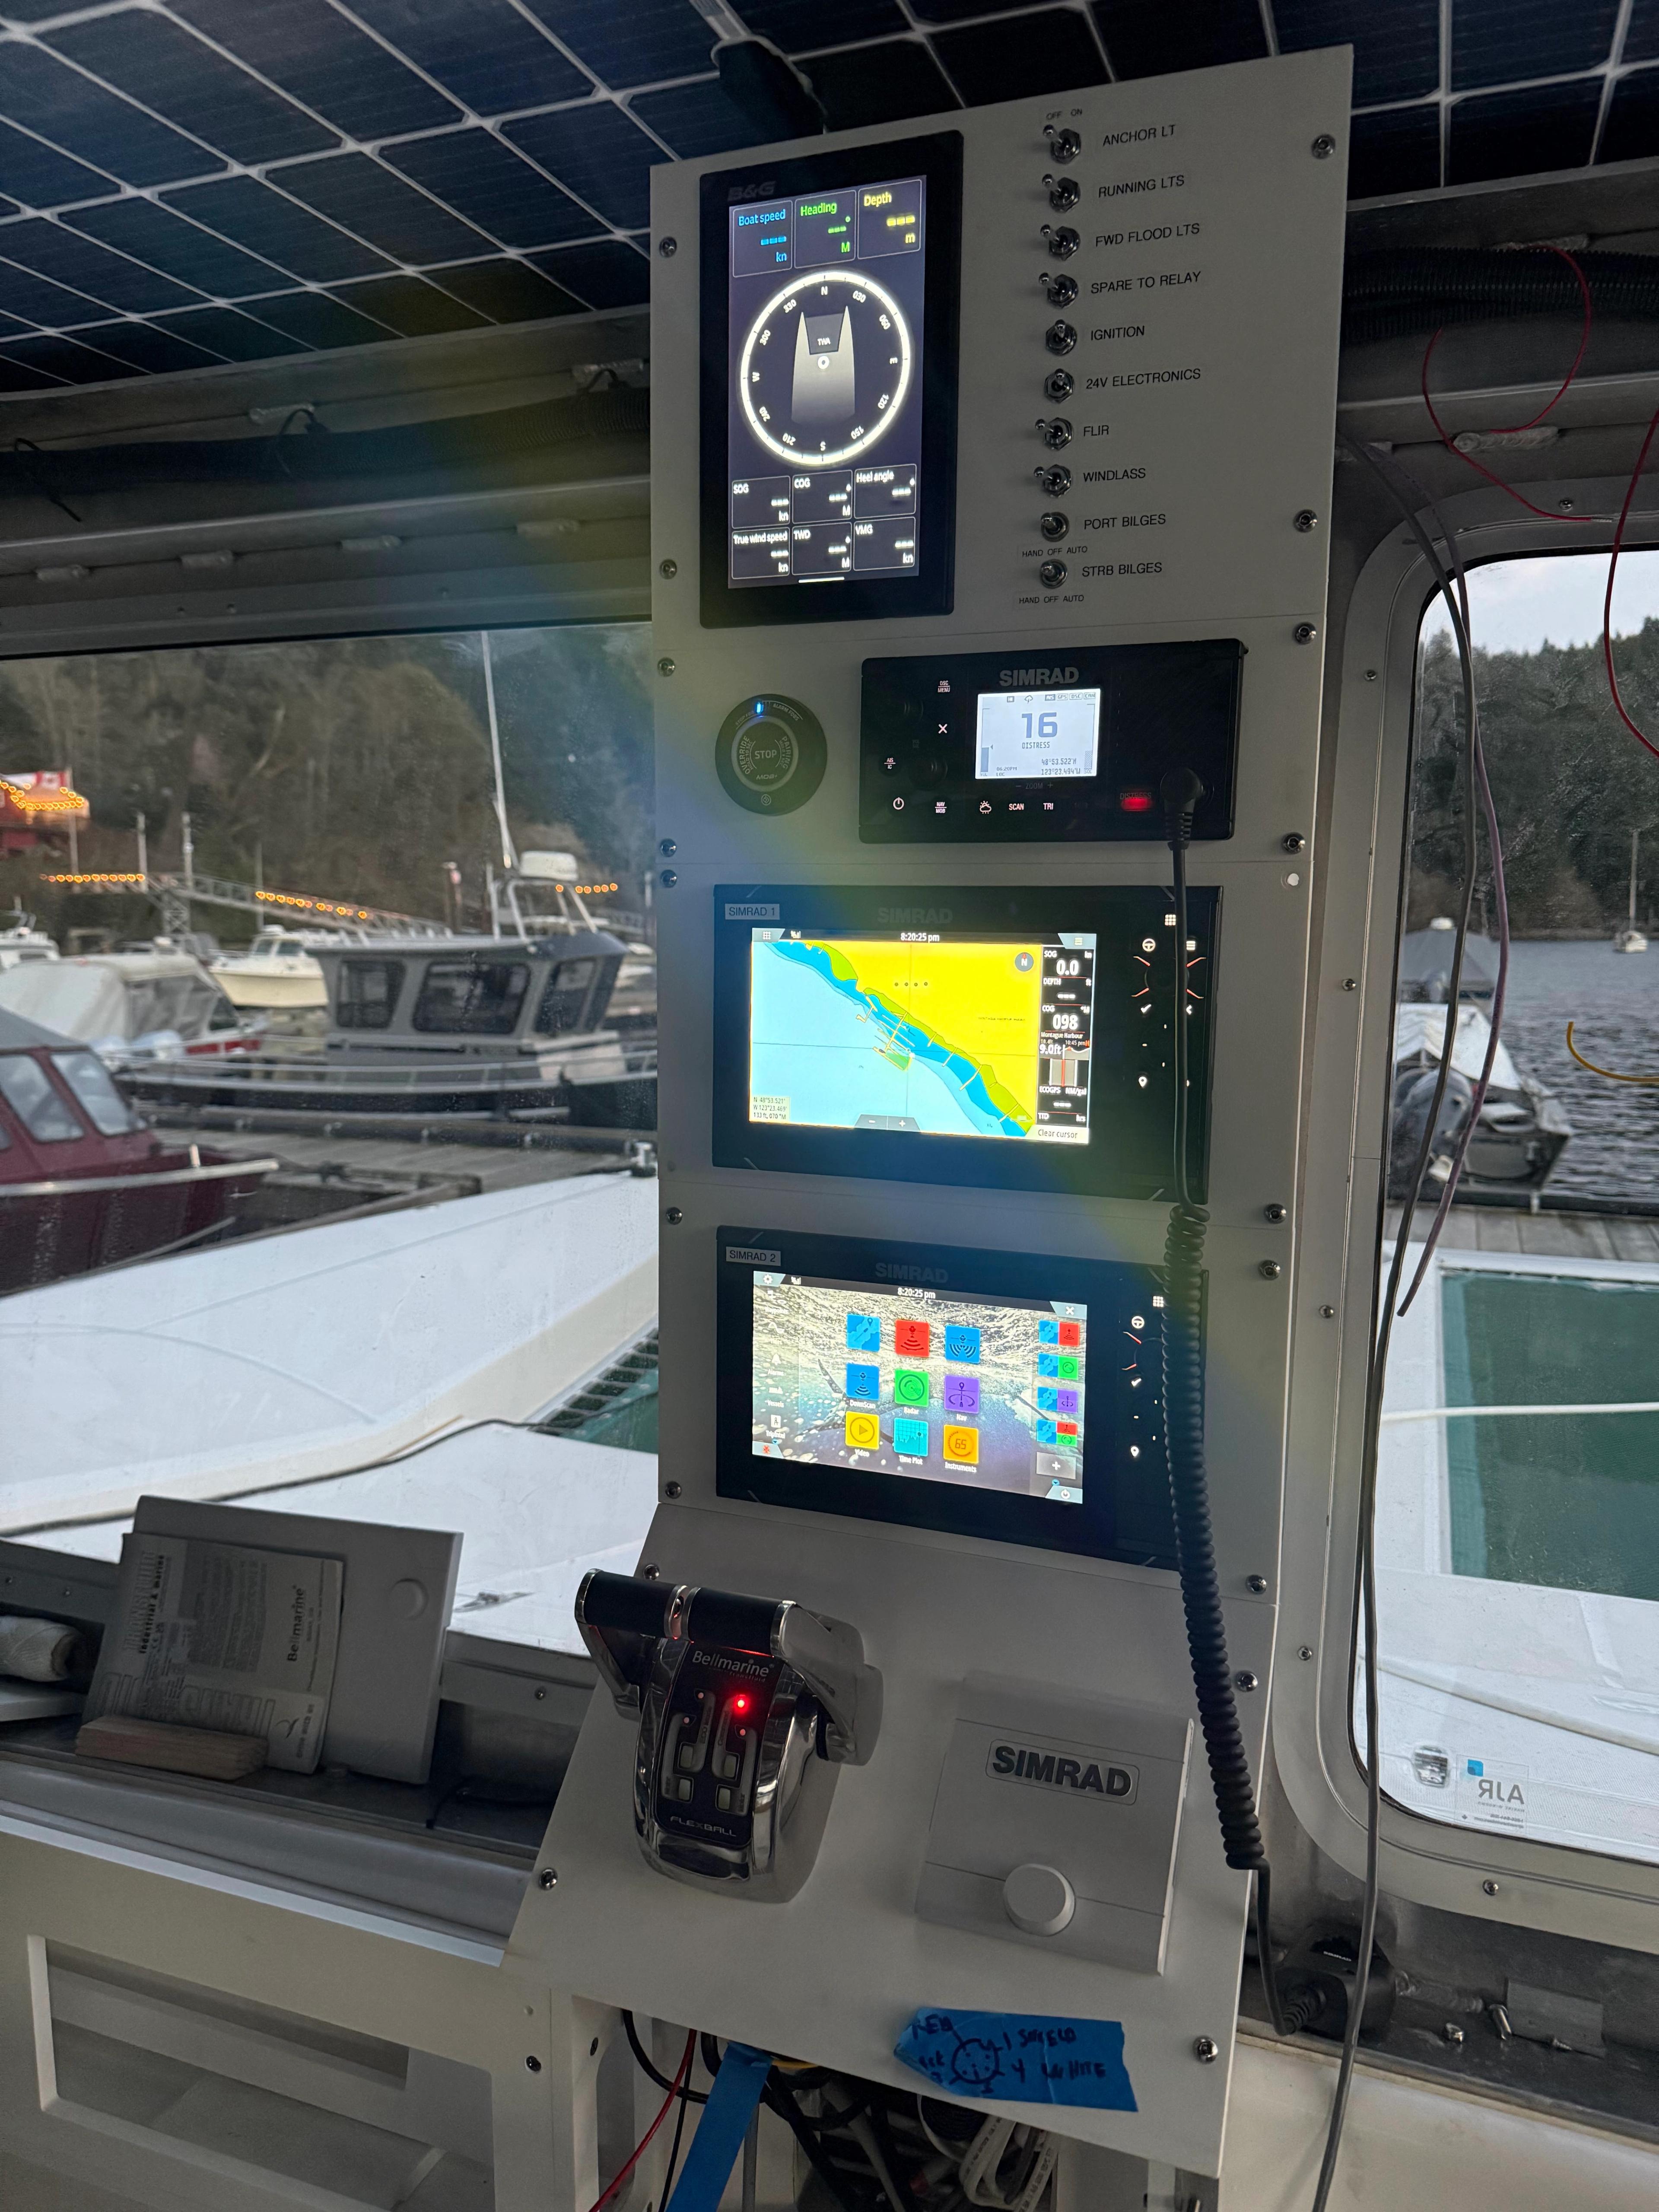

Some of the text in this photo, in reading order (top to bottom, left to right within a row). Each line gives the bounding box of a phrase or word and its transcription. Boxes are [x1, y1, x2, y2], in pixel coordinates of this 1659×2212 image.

[1046, 111, 1062, 120] OFF
[1103, 125, 1176, 146] ANCHOR LT
[728, 181, 775, 201] B&G
[1098, 175, 1184, 198] RUNNING LTS
[864, 192, 892, 208] Depth
[800, 203, 837, 216] Heading
[739, 209, 785, 226] Boat speed
[905, 234, 915, 244] m
[1096, 223, 1200, 247] FWD FLOOD LTS
[841, 242, 850, 252] M
[776, 251, 787, 263] kn
[1091, 271, 1201, 293] SPARE TO RELAY
[821, 286, 828, 295] N
[852, 290, 866, 303] 030
[783, 299, 797, 313] 330
[760, 330, 771, 346] 300
[1091, 326, 1144, 340] IGNITION
[1086, 369, 1201, 389] 24V ELECTRONICS
[877, 394, 889, 409] 120
[759, 406, 771, 422] 240
[850, 426, 864, 440] 150
[1084, 425, 1109, 436] FLIR
[782, 433, 796, 445] 210
[820, 442, 826, 451] S
[857, 470, 894, 483] Heel angle
[1084, 468, 1146, 482] WINDLASS
[733, 483, 749, 494] SOG
[794, 478, 810, 489] COG
[779, 511, 789, 521] kn
[842, 505, 850, 516] M
[1084, 514, 1166, 530] PORT BILGES
[794, 530, 811, 540] TWD
[855, 524, 873, 535] VMG
[734, 531, 788, 544] True wind speed
[842, 557, 850, 568] M
[903, 553, 913, 563] kn
[778, 562, 788, 572] kn
[1082, 563, 1162, 577] STRB BILGES
[999, 667, 1079, 686] SIMRAD
[1022, 712, 1057, 738] 16
[739, 735, 750, 775] OVERRIDE
[755, 750, 777, 759] STOP
[782, 736, 791, 769] PAIRING
[729, 907, 775, 917] SIMRAD 1
[877, 908, 953, 924] SIMRAD
[900, 932, 940, 942] 8:20:25 pm
[1056, 960, 1079, 975] 0.0
[1053, 1014, 1078, 1030] 098
[1076, 1114, 1086, 1122] hrs
[1038, 1129, 1055, 1137] Clear
[729, 1250, 776, 1263] SIMRAD 2
[875, 1262, 949, 1284] SIMRAD
[897, 1287, 935, 1300] 8:20:25 pm
[850, 1400, 876, 1409] DownScan
[955, 1439, 966, 1449] 65
[855, 1449, 869, 1457] Video
[899, 1455, 912, 1464] Time
[945, 1462, 977, 1473] Instruments
[287, 1587, 304, 1662] Bellmarine
[693, 1650, 769, 1677] Bellmarine
[992, 1746, 1131, 1796] SIMRAD
[671, 1816, 737, 1837] FLEXBALL
